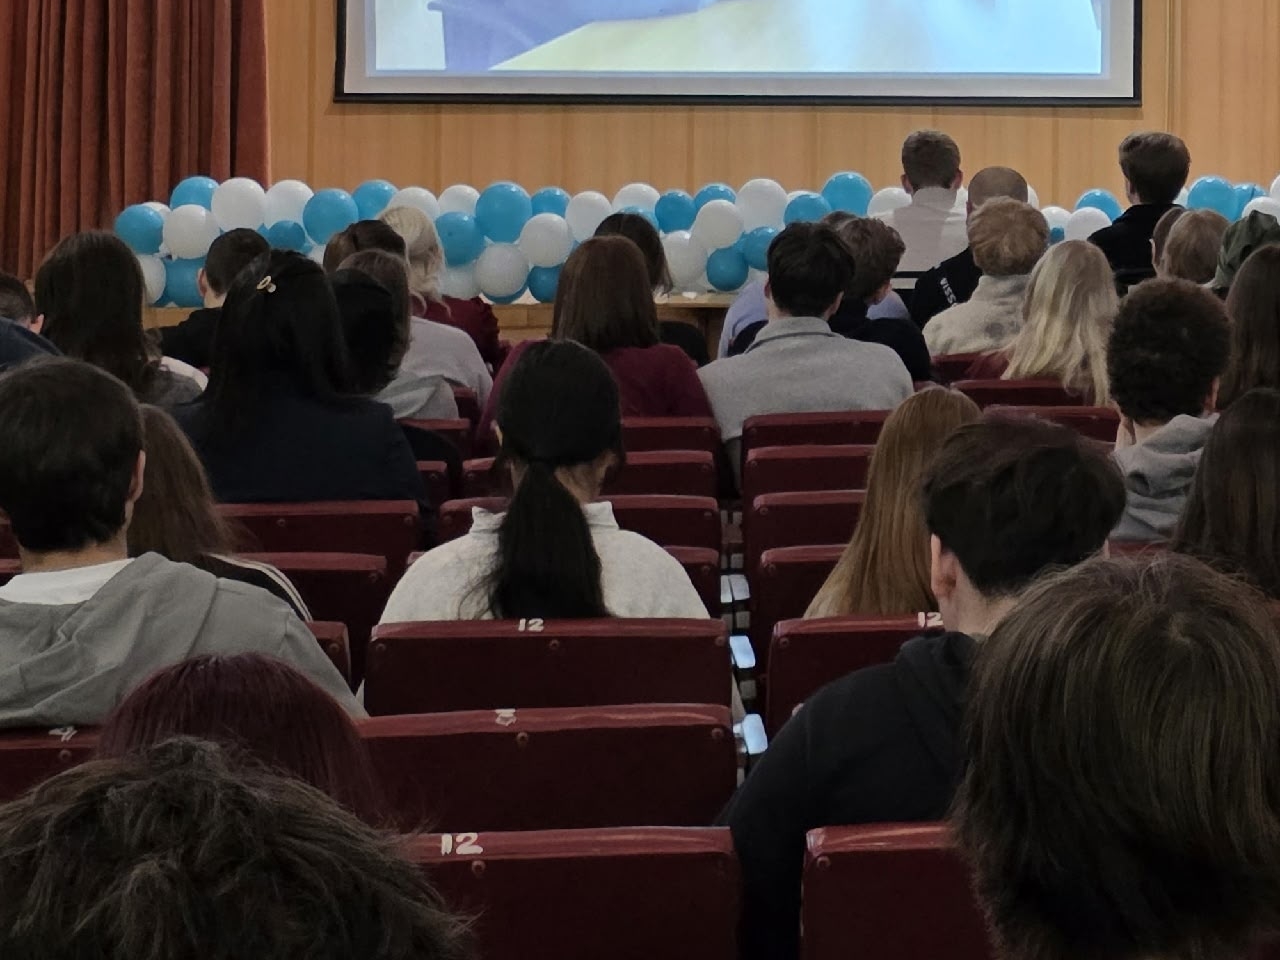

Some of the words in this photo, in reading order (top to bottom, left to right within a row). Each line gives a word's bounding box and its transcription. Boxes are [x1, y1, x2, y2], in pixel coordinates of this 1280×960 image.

[518, 618, 545, 632] 12
[917, 611, 944, 628] 12
[441, 832, 484, 856] 12
